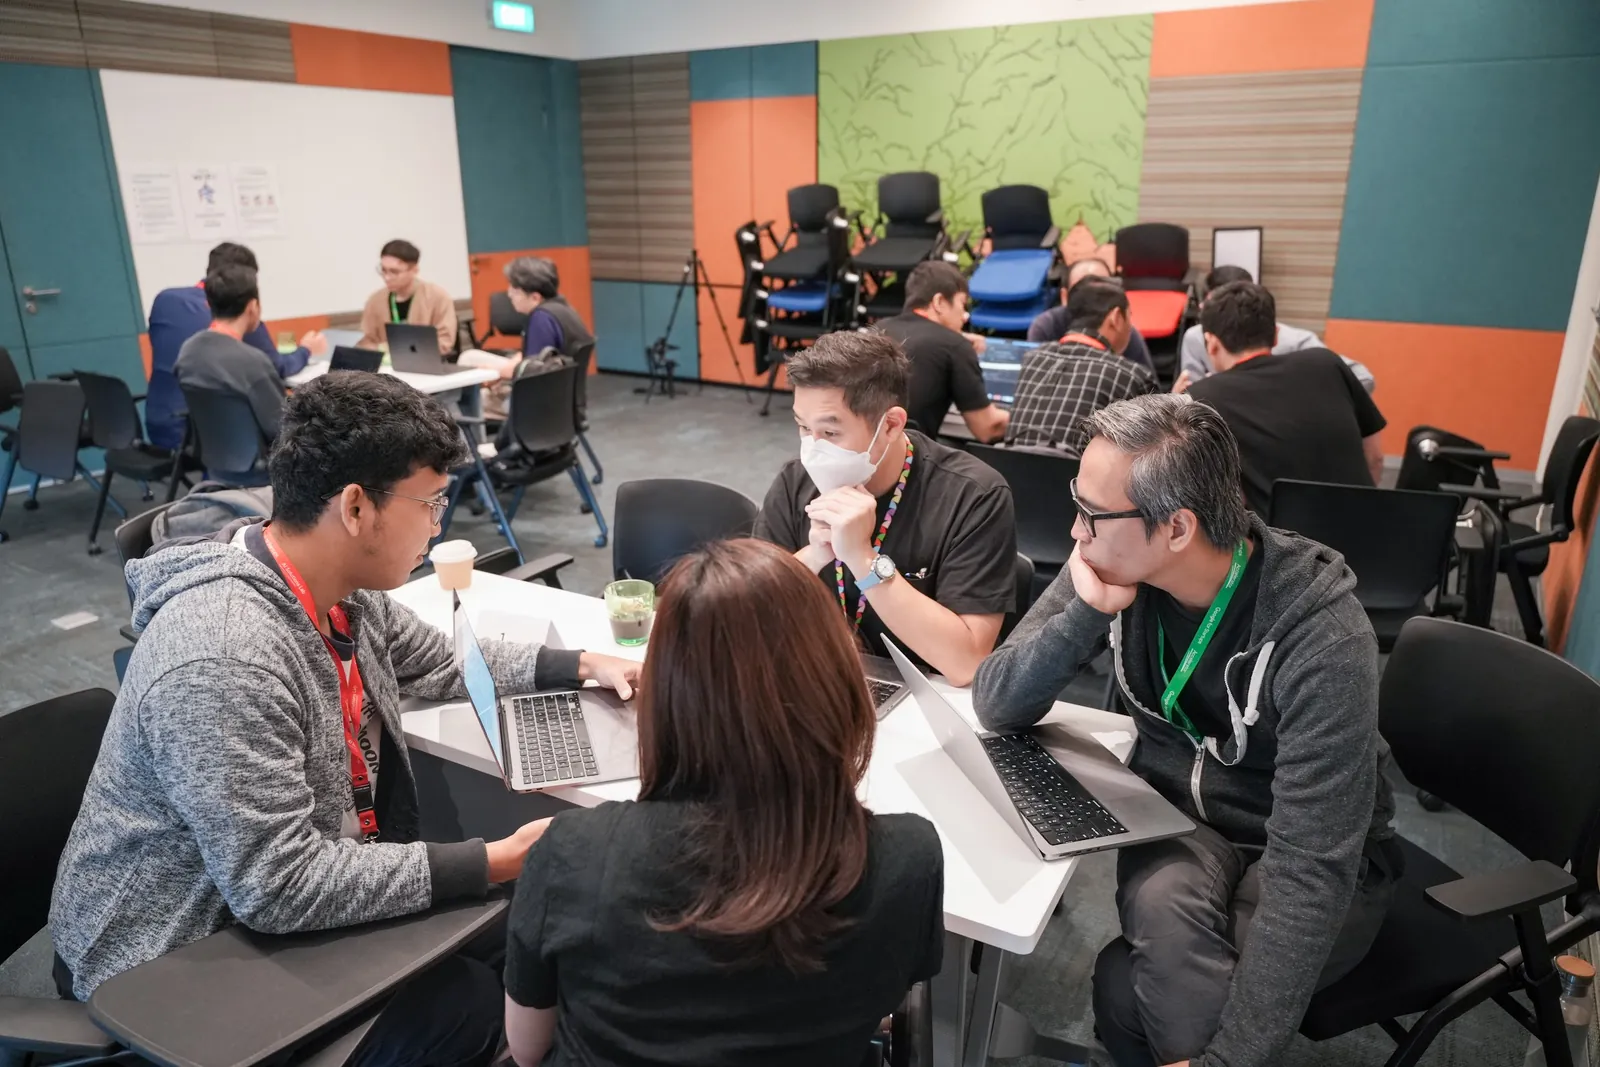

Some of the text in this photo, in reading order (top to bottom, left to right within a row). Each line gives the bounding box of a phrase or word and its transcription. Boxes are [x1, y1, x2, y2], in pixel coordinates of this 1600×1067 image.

[298, 585, 306, 594] Lab
[1209, 606, 1221, 623] Google
[1197, 627, 1210, 645] Startups
[1183, 649, 1198, 673] Accelerator
[1164, 690, 1174, 705] Google
